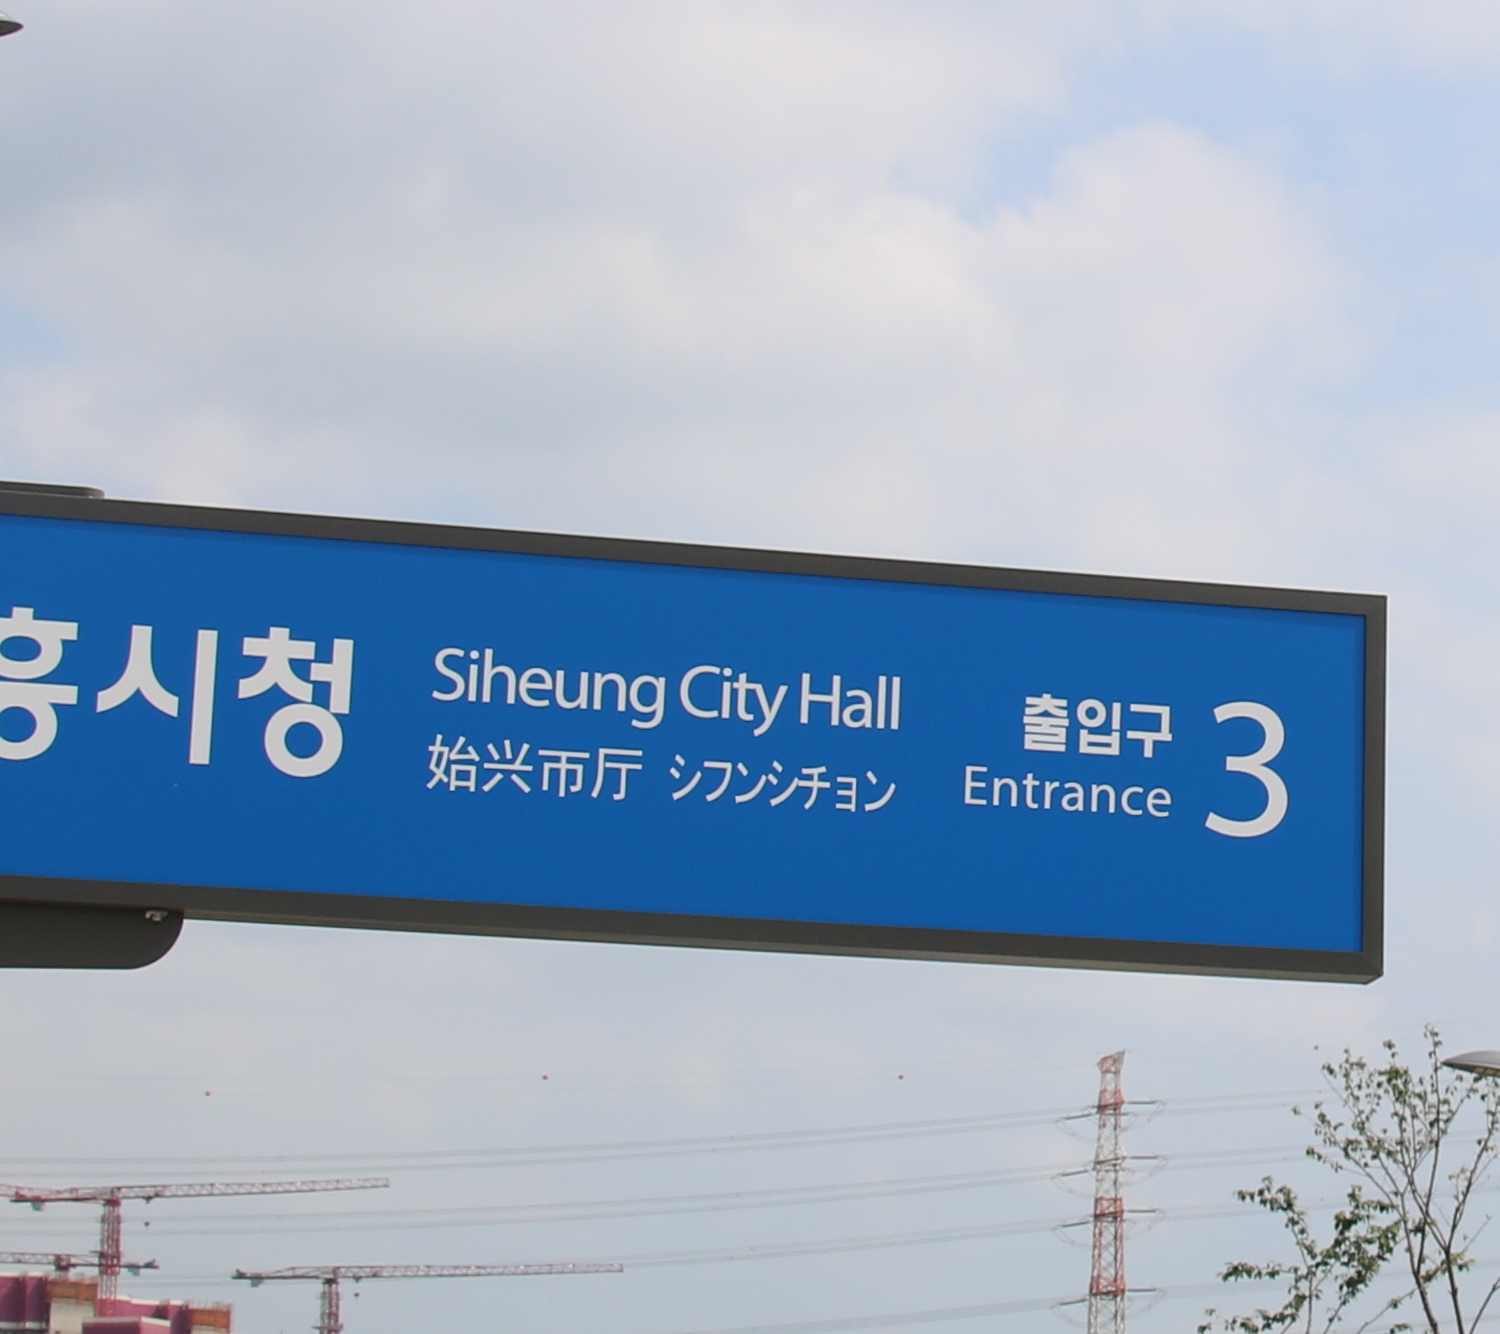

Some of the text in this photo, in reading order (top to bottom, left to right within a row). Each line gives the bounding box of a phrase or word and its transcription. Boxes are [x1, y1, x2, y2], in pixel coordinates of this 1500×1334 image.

[431, 647, 901, 737] Siheung City Hall
[1022, 693, 1173, 759] 출입구
[669, 754, 896, 813] シフンシチョン
[964, 765, 1172, 818] Entrance
[1204, 701, 1289, 838] 3
